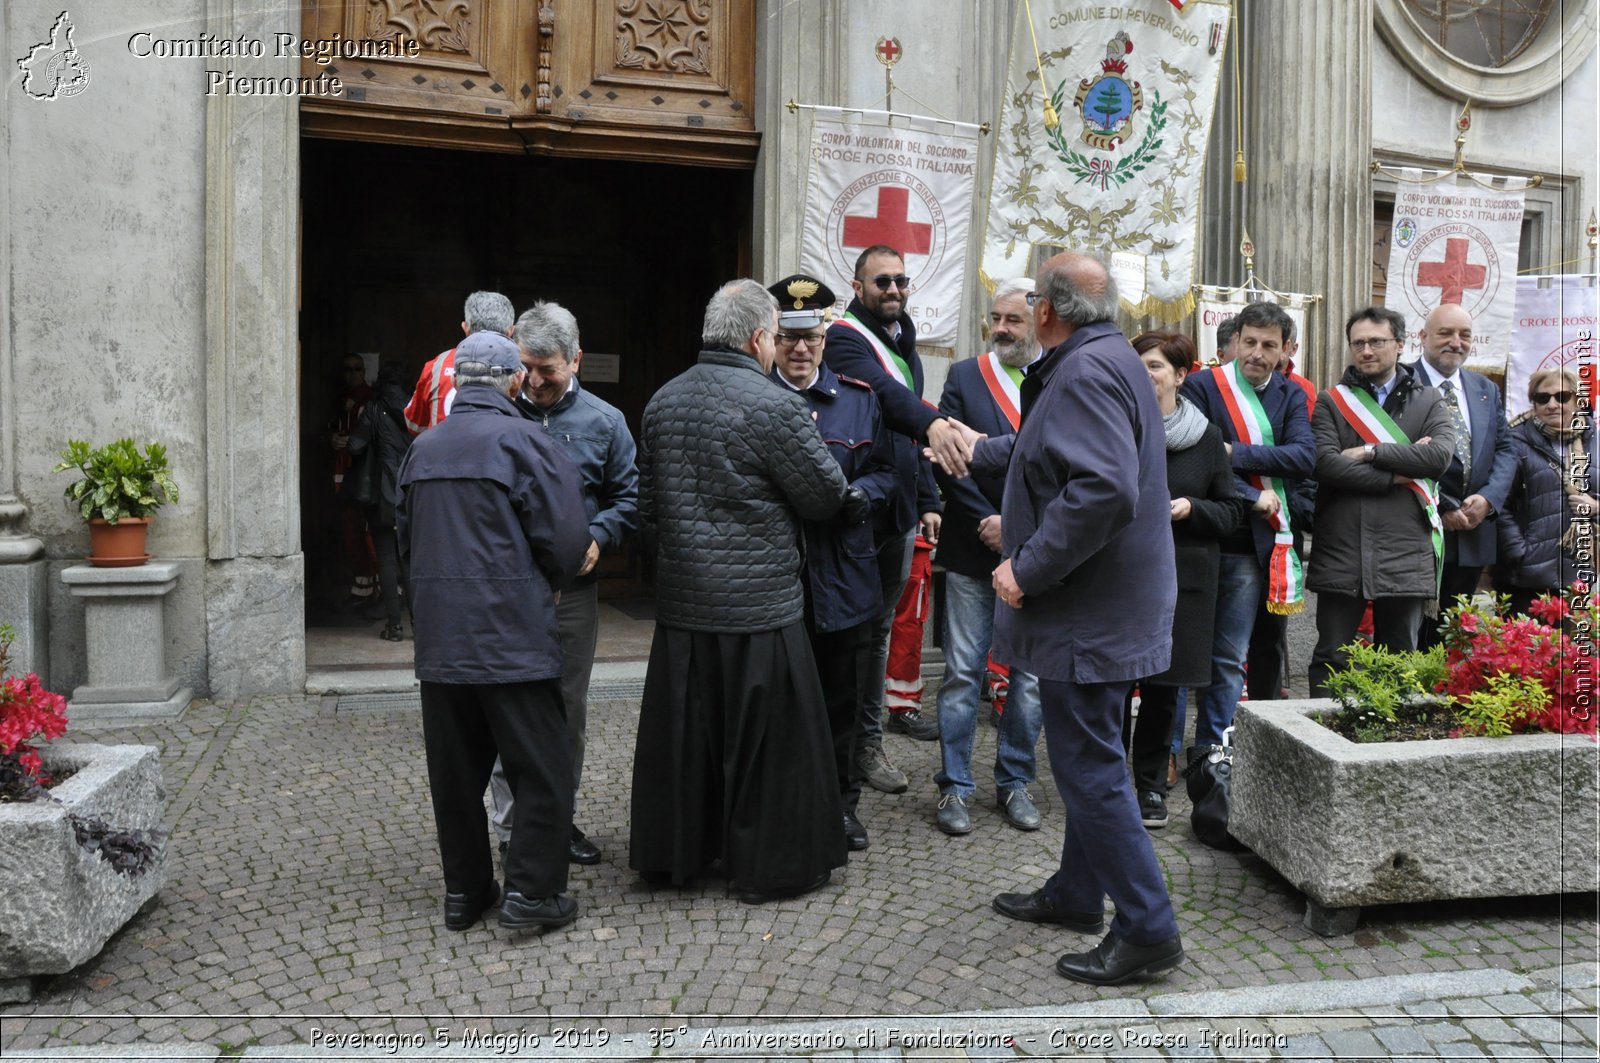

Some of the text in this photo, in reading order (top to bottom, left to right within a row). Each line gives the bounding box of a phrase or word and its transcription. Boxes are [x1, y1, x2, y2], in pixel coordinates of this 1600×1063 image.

[1050, 7, 1199, 47] COMUNE DI PEVERAGNO
[821, 132, 967, 159] CORPO VOLONTARI DEL SOCCORSO
[865, 152, 913, 168] ROSSA
[916, 158, 973, 176] ITALIANA
[833, 171, 944, 226] CONVENZIONE DI GINEVRA
[1402, 193, 1520, 210] CORPO VOLONTARI DEL SOCCORSO
[1396, 205, 1522, 222] CROCE ROSSA ITALIANA
[1408, 224, 1463, 262] CONVENZIONE
[1466, 224, 1475, 234] DI
[1475, 232, 1497, 266] GINEVRA
[925, 306, 939, 318] DI
[1519, 317, 1559, 328] CROCE
